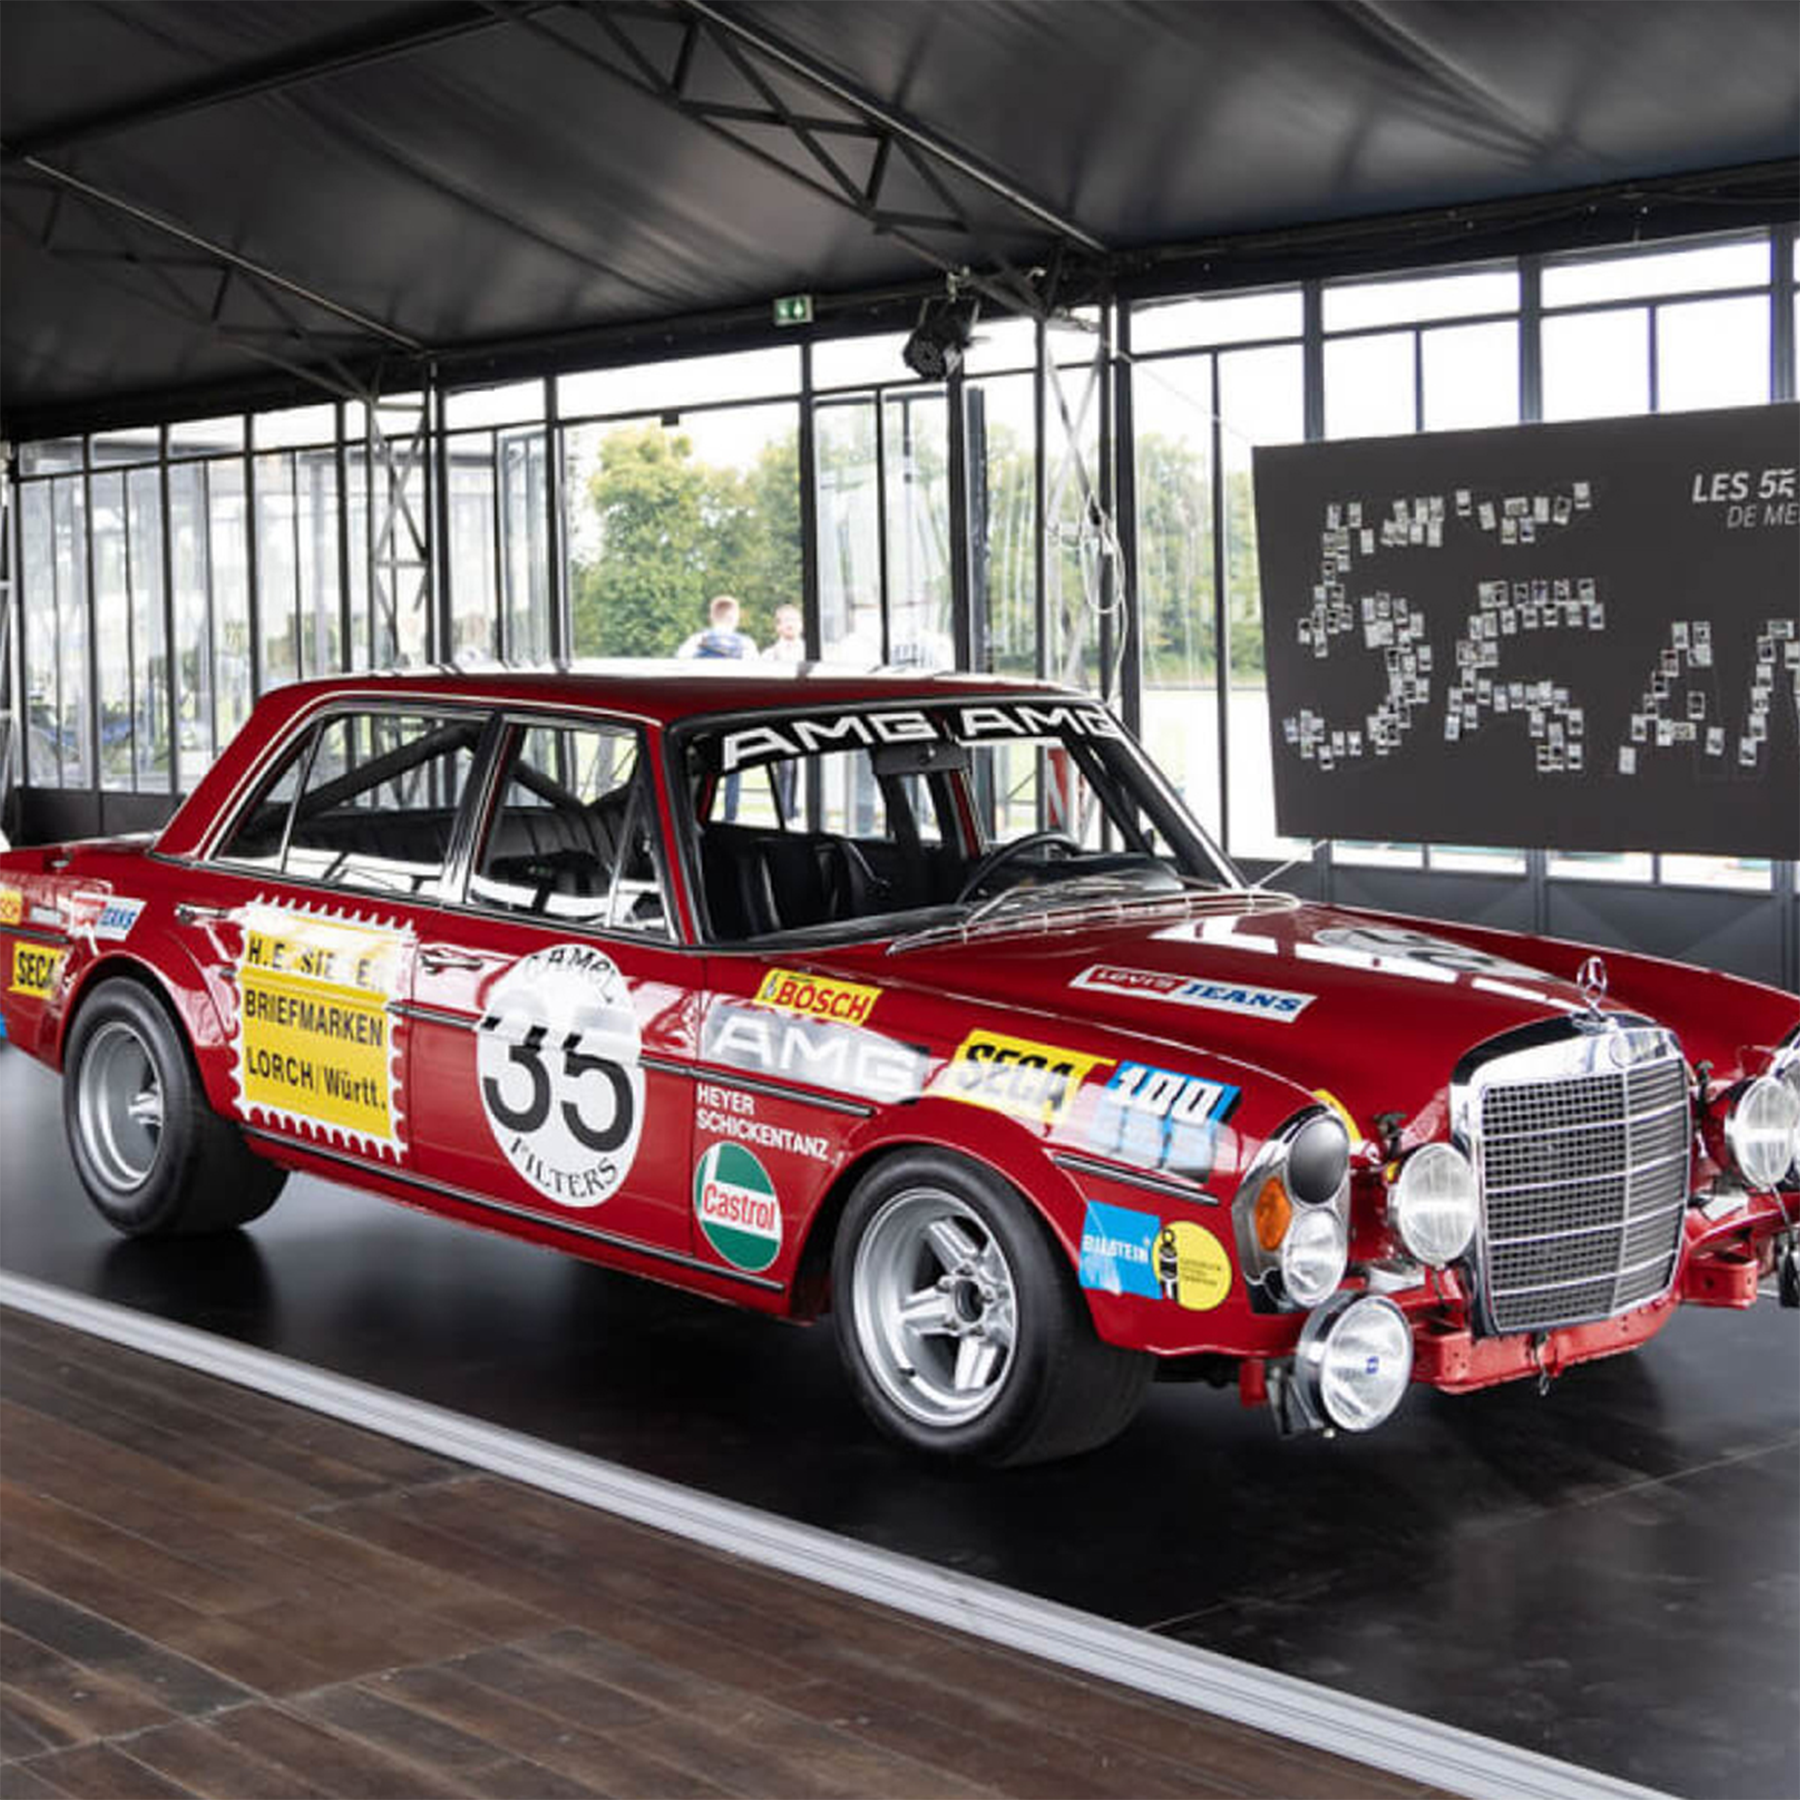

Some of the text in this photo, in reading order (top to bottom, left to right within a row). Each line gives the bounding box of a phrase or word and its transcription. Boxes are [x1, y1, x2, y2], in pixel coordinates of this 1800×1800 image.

[1692, 471, 1749, 502] LES
[1726, 502, 1800, 529] DE ME
[723, 710, 939, 772] AMG
[960, 706, 1122, 738] AMG
[244, 989, 383, 1046] BRIEFMARKEN
[774, 980, 871, 1021] BOSCH
[1182, 983, 1302, 1011] JEANS
[710, 1014, 920, 1096] AMG
[480, 1016, 635, 1153] 35
[697, 1083, 755, 1115] HEYER
[1110, 1066, 1224, 1126] 100
[696, 1108, 829, 1161] SCHICKENTANZ
[703, 1182, 776, 1230] Castrol
